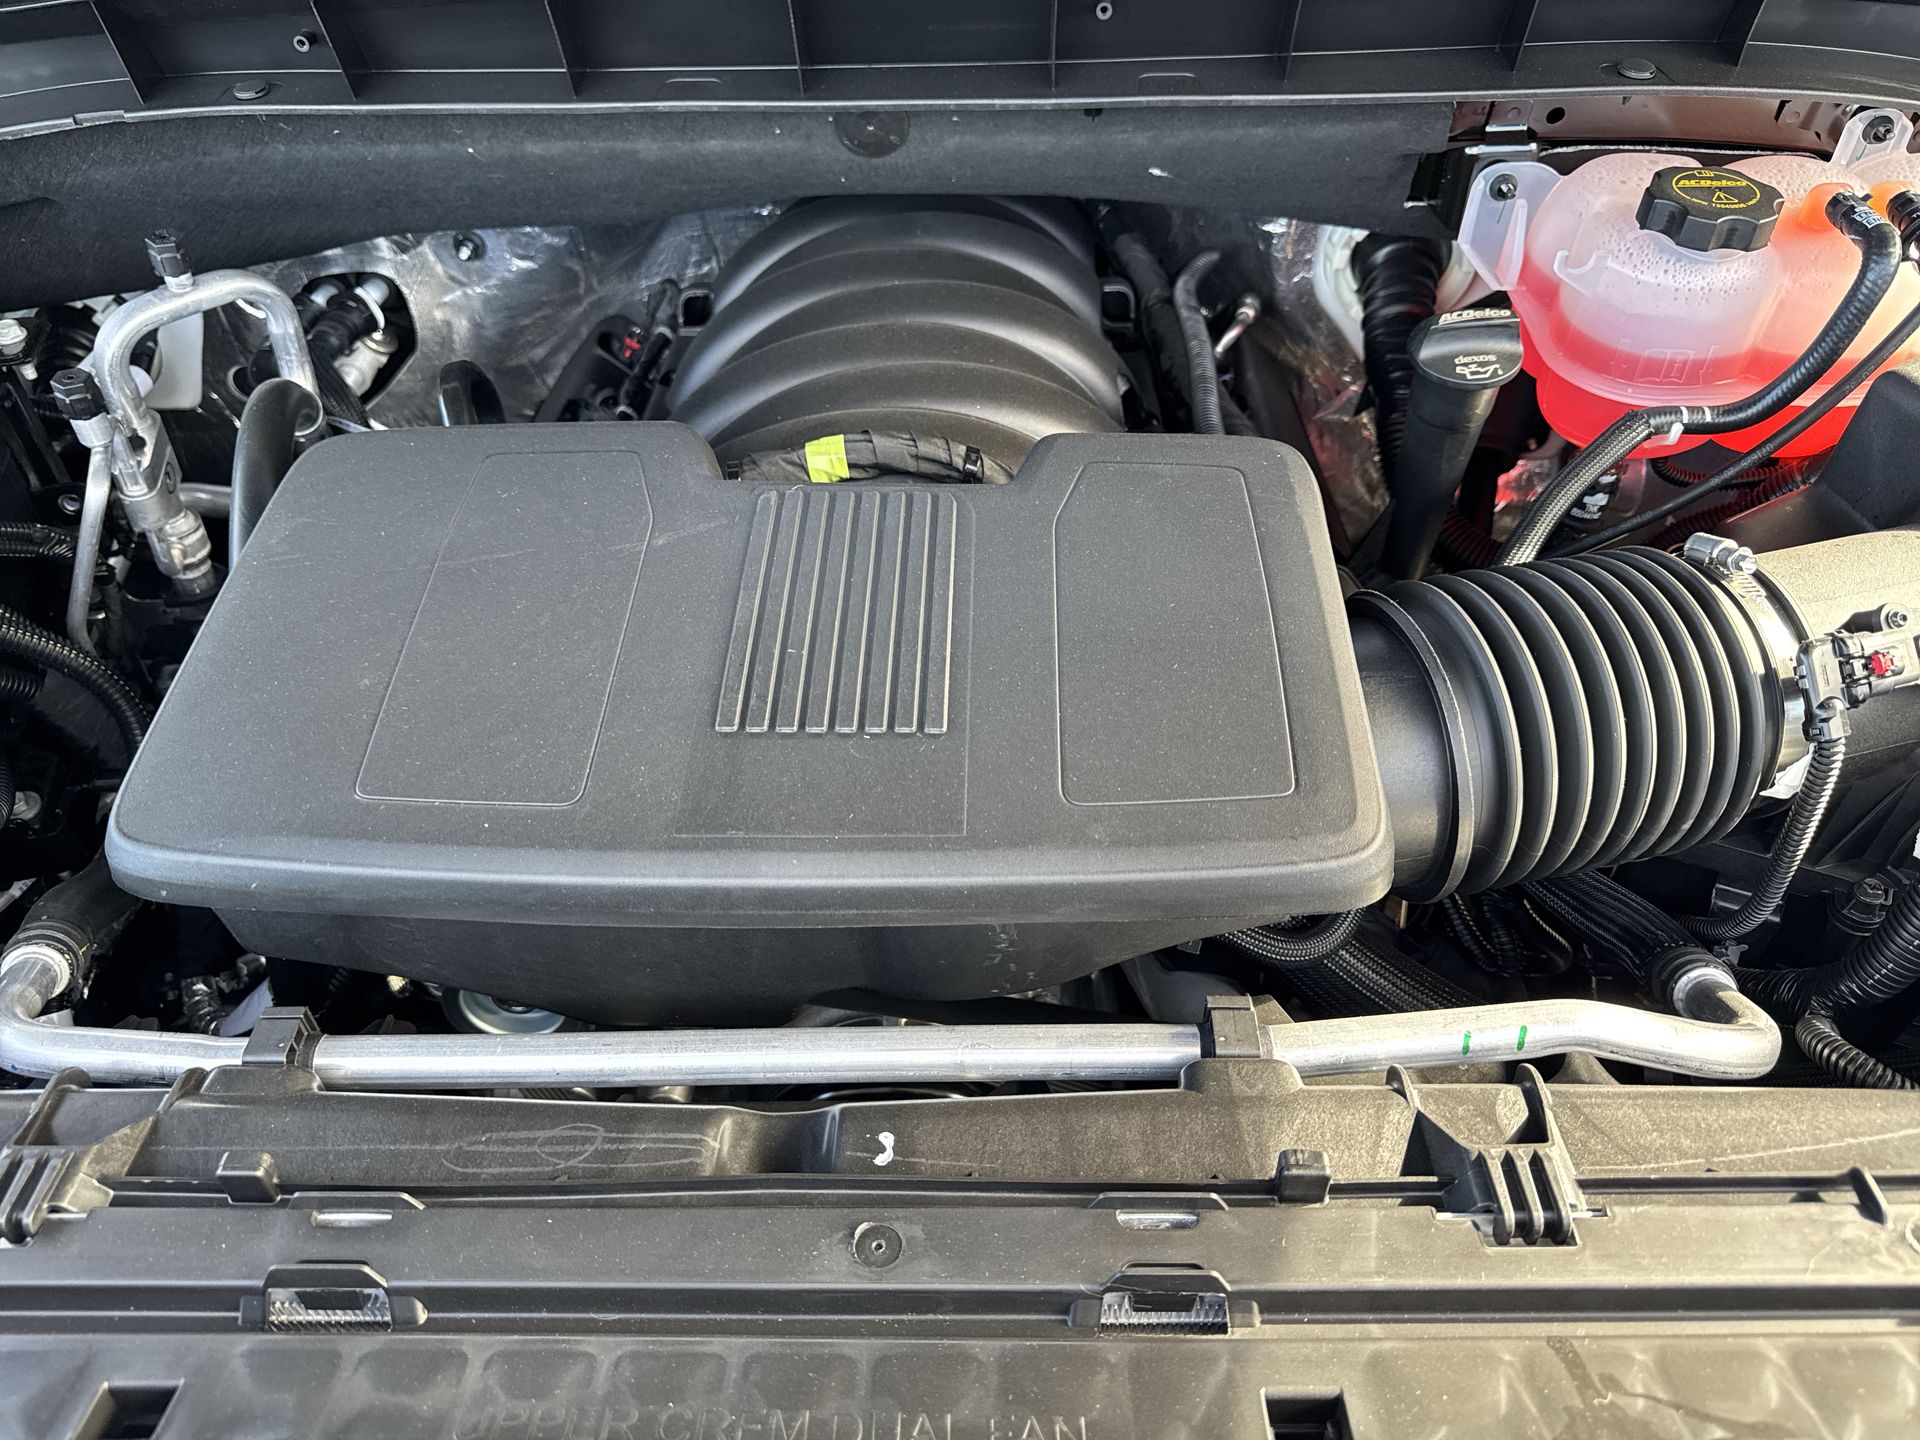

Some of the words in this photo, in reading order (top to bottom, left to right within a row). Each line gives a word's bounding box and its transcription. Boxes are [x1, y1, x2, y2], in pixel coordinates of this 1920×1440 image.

[1676, 179, 1748, 187] ACDelco
[1438, 308, 1512, 325] ACDelco
[1454, 354, 1497, 364] dexos
